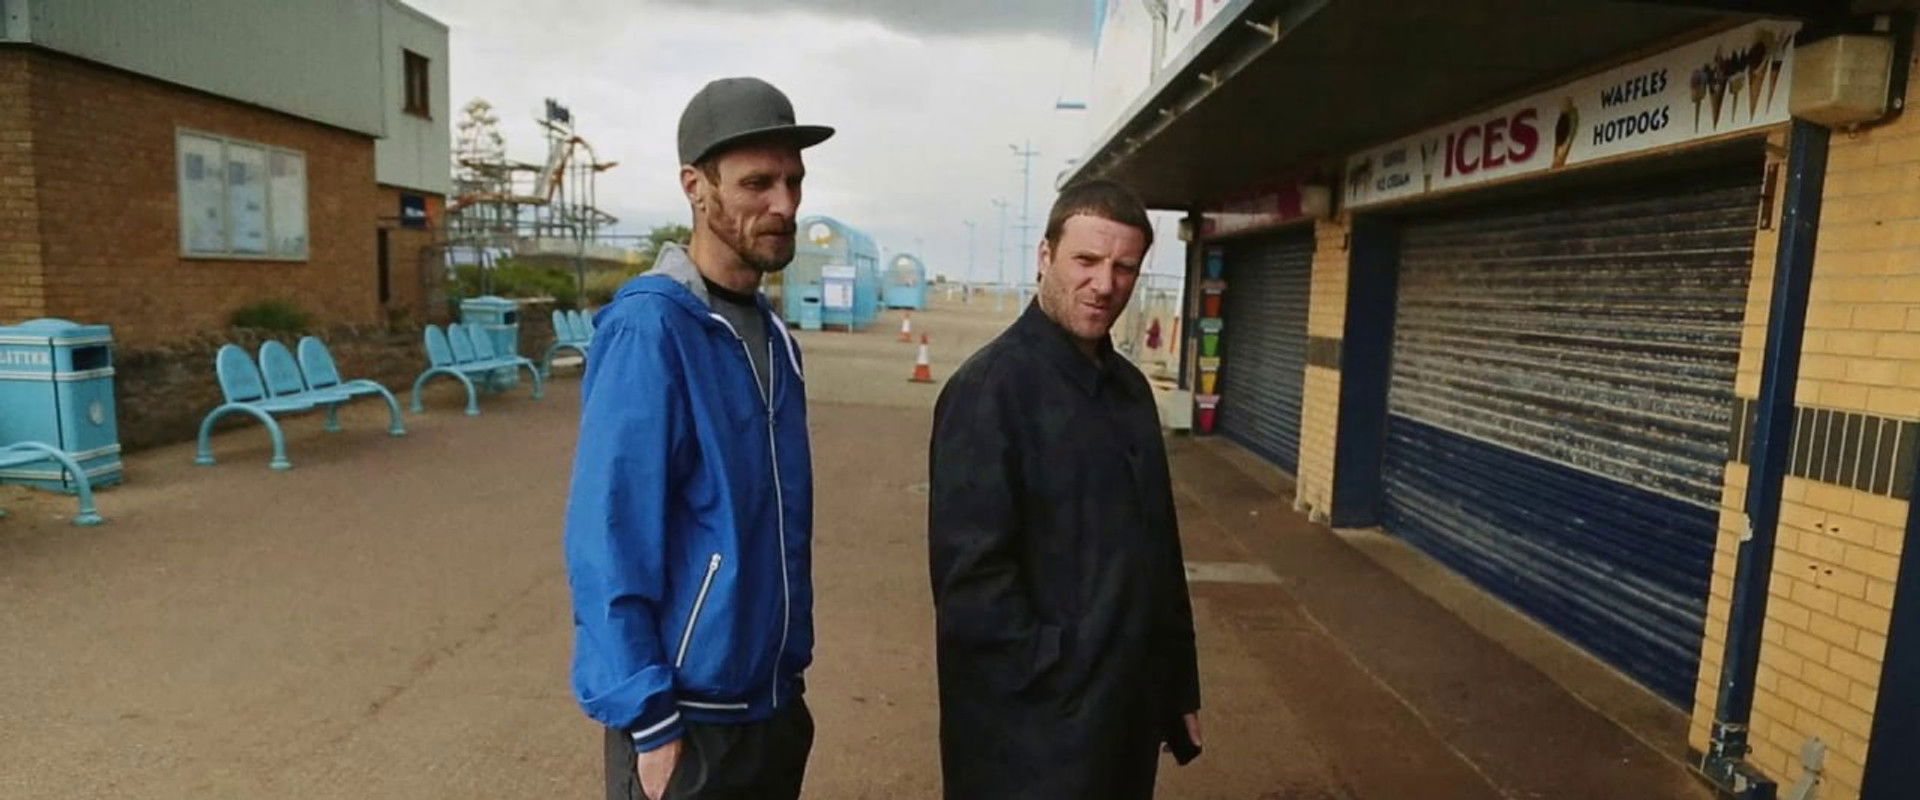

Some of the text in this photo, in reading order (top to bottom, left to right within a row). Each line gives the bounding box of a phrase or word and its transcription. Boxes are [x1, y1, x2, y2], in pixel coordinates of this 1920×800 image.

[1601, 68, 1668, 109] WAFFLES
[1444, 108, 1540, 178] ICES
[1593, 105, 1670, 146] HOTDOGS
